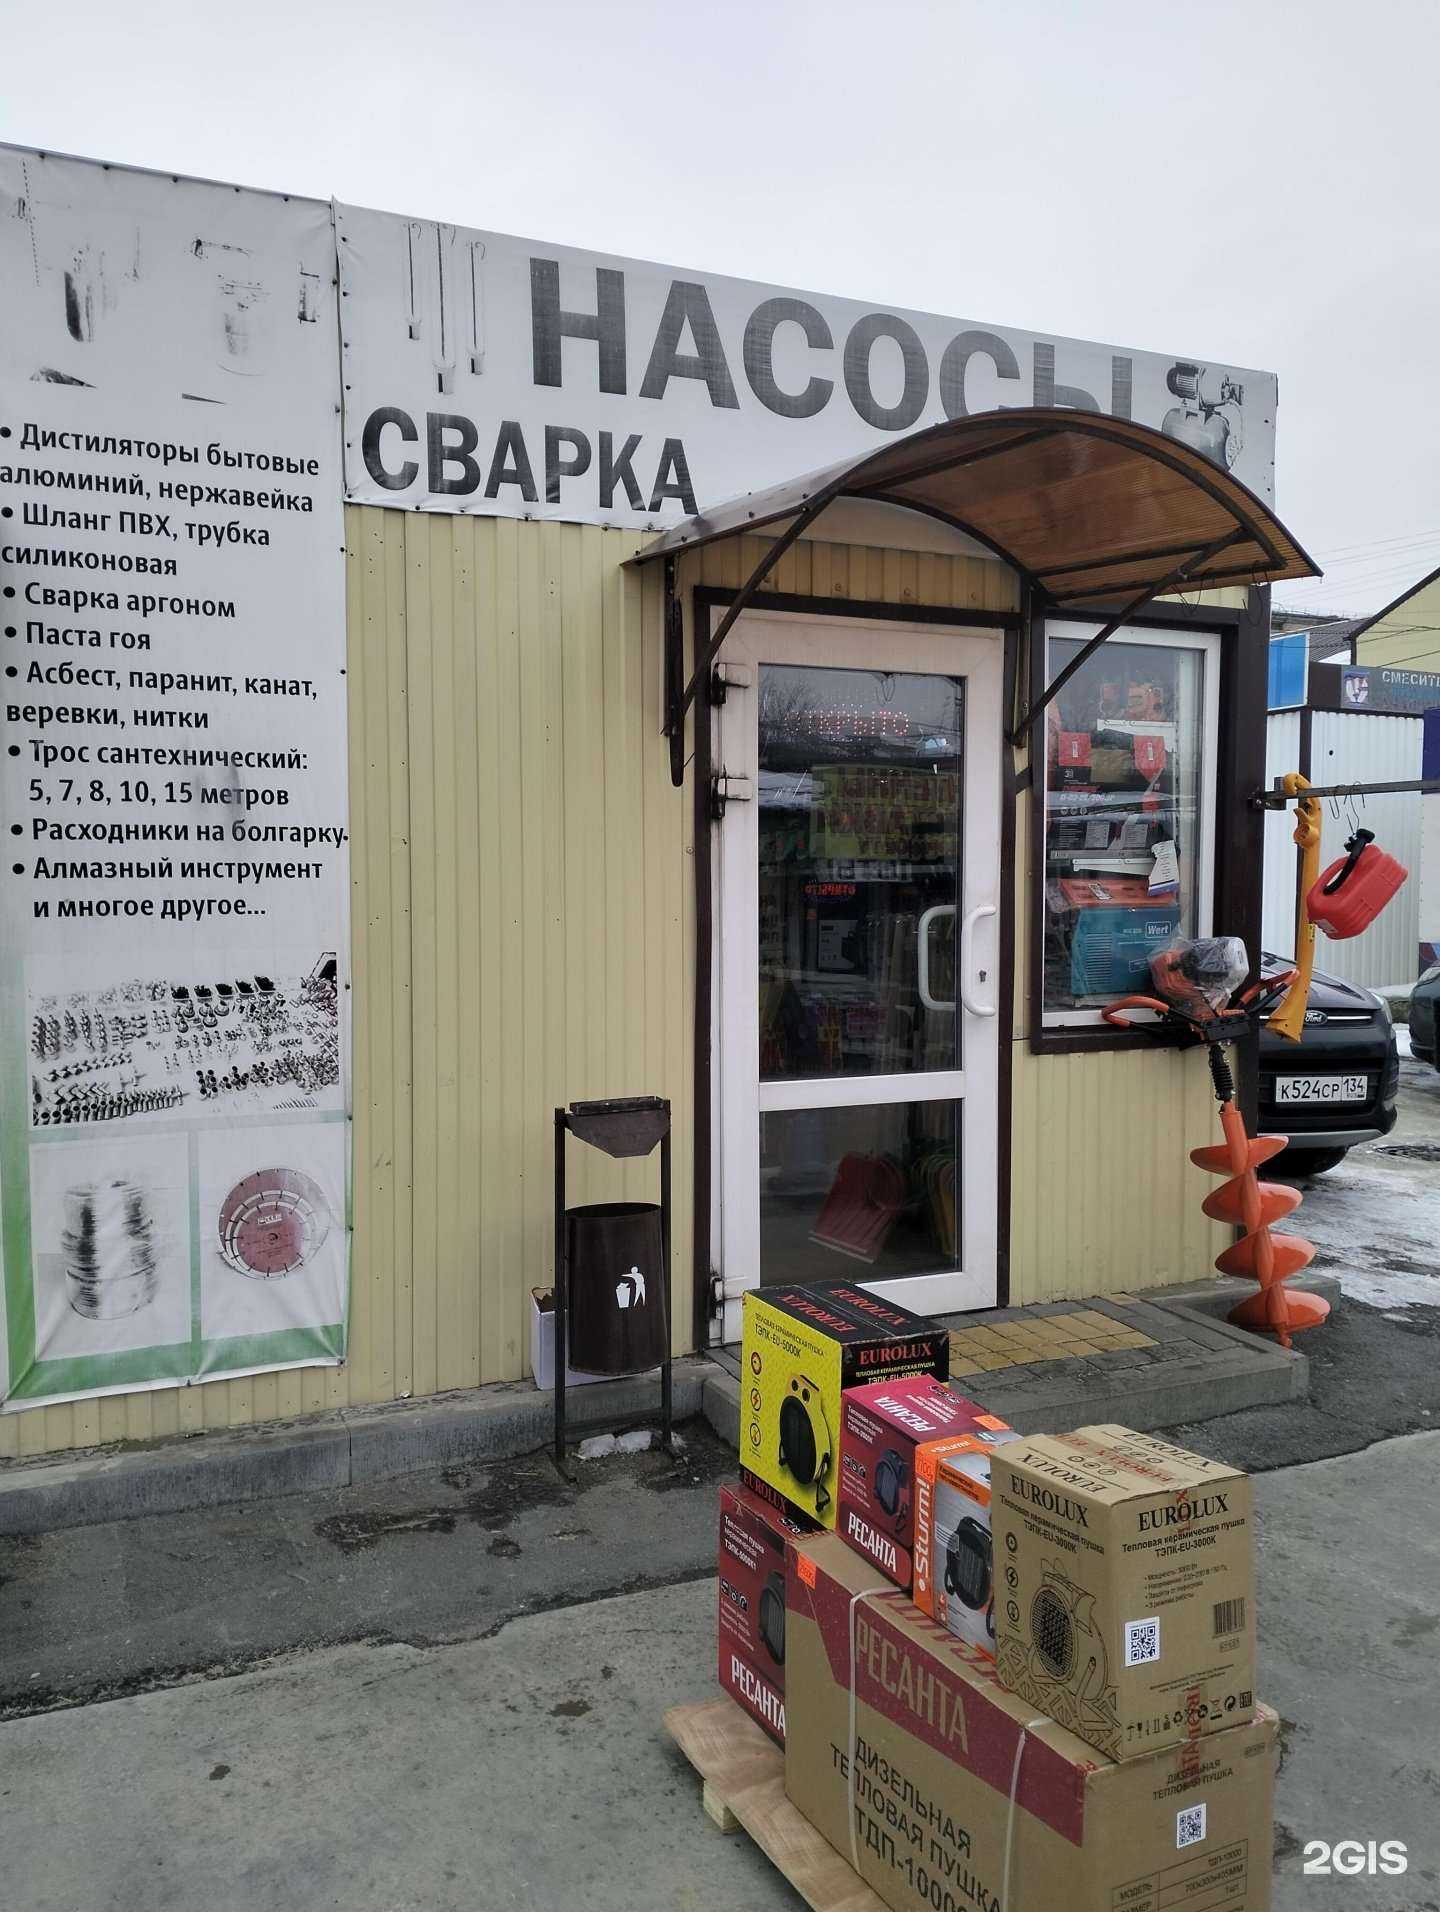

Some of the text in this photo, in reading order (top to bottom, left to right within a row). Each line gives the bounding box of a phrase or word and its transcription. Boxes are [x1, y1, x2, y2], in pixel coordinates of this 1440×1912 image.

[530, 257, 1132, 433] НАСОСЫ
[20, 423, 319, 476] Дистиляторы бытовые
[362, 406, 700, 515] СВАРКА
[0, 465, 313, 512] алюминий, нержавейка
[23, 502, 270, 547] Шланг ПВХ, трубка
[1, 545, 177, 576] силиконовая
[25, 582, 235, 617] Сварка аргоном
[26, 621, 151, 650] Паста гоя
[26, 661, 317, 700] Асбест, паранит, канат,
[6, 704, 209, 729] веревки, нитки
[28, 740, 308, 770] Трос сантехнический:
[29, 779, 289, 810] 5, 7, 8, 10, 15 метров
[32, 818, 345, 848] Расходники на болгарку
[33, 857, 322, 884] Алмазный инструмент
[33, 898, 266, 921] и многое другое...
[1343, 1078, 1364, 1092] 134
[777, 1294, 858, 1332] EUROLUX
[829, 1288, 911, 1325] EUROLUX
[860, 1342, 933, 1366] EUROLUX
[873, 1397, 936, 1432] РЕСАНТА
[1017, 1454, 1107, 1494] EUROLUX
[1010, 1474, 1089, 1528] EUROLUX
[1138, 1494, 1229, 1532] EUROLUX
[848, 1511, 896, 1573] РЕСАНТА
[916, 1478, 930, 1578] Sturm!
[1122, 1518, 1245, 1553] Тепловая керамическая пушка
[731, 1655, 786, 1737] РЕСАНТА
[856, 1617, 969, 1754] РЕСАНТА
[831, 1742, 923, 1852] ТЕПЛОВАЯ
[855, 1736, 971, 1859] ДИЗЕЛЬНАЯ
[855, 1804, 967, 1912] ТДП-1000
